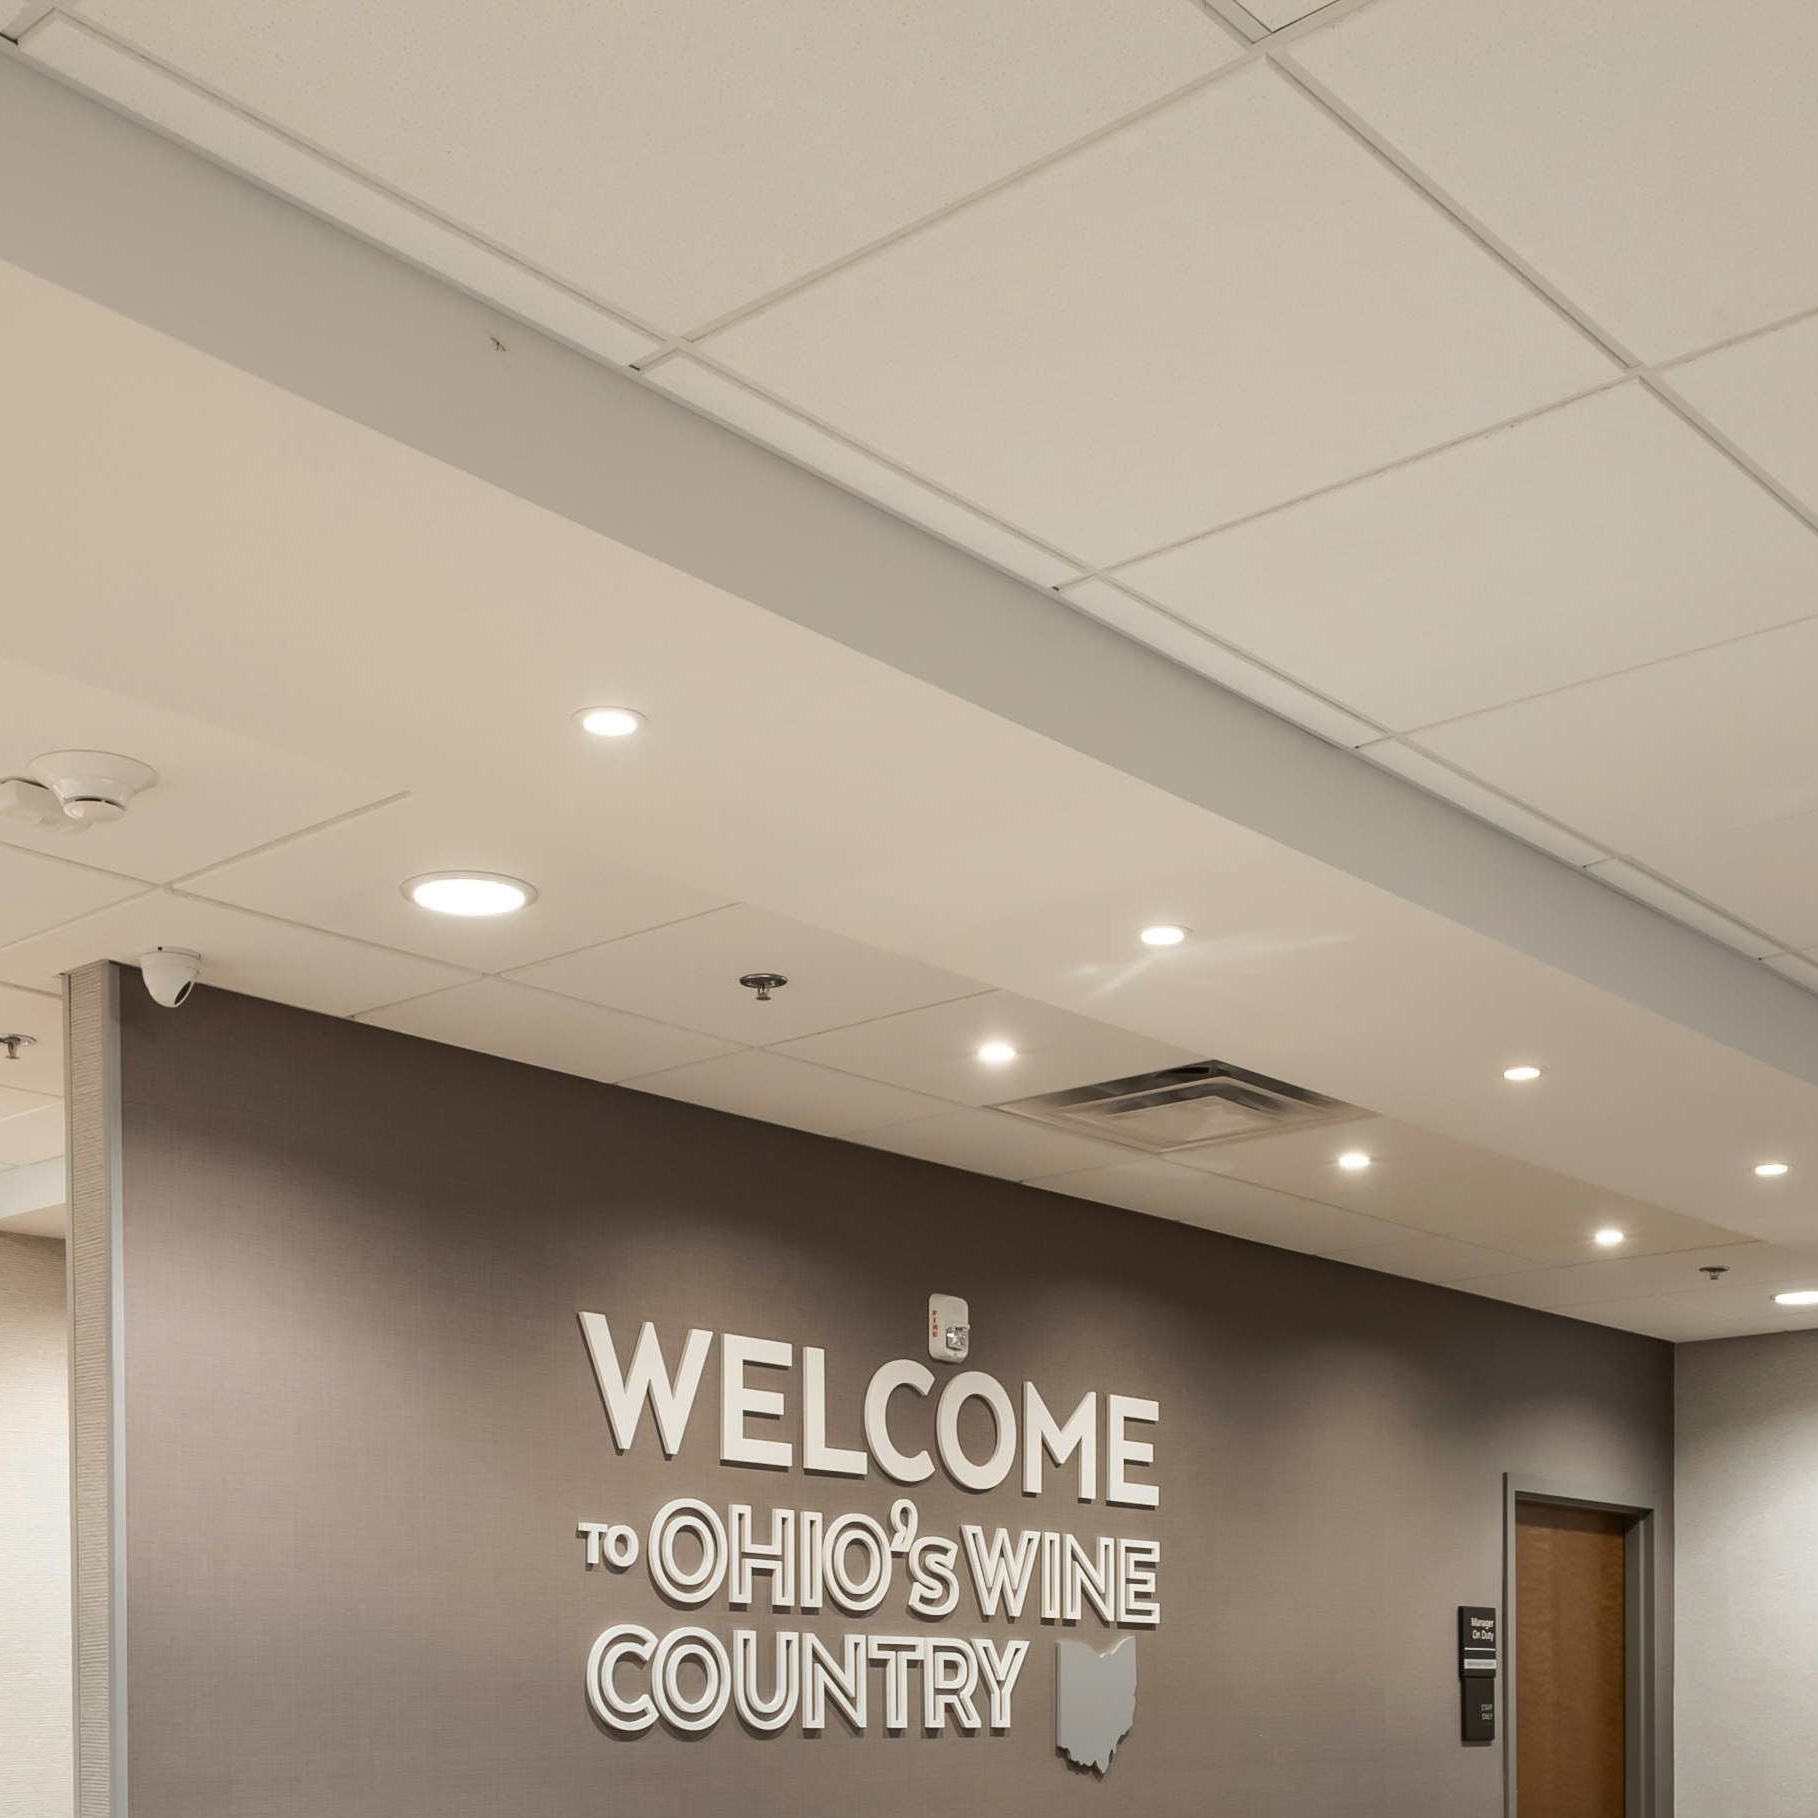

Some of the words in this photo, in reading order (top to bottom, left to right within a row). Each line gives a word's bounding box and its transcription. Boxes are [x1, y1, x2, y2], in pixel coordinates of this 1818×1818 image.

[577, 1310, 1161, 1508] WELCOME
[577, 1521, 640, 1568] TO
[960, 1524, 1161, 1625] WINE
[1470, 1617, 1495, 1629] Manager
[585, 1623, 1032, 1732] COUNTRY
[1472, 1629, 1481, 1640] On
[1481, 1629, 1495, 1642] Duty
